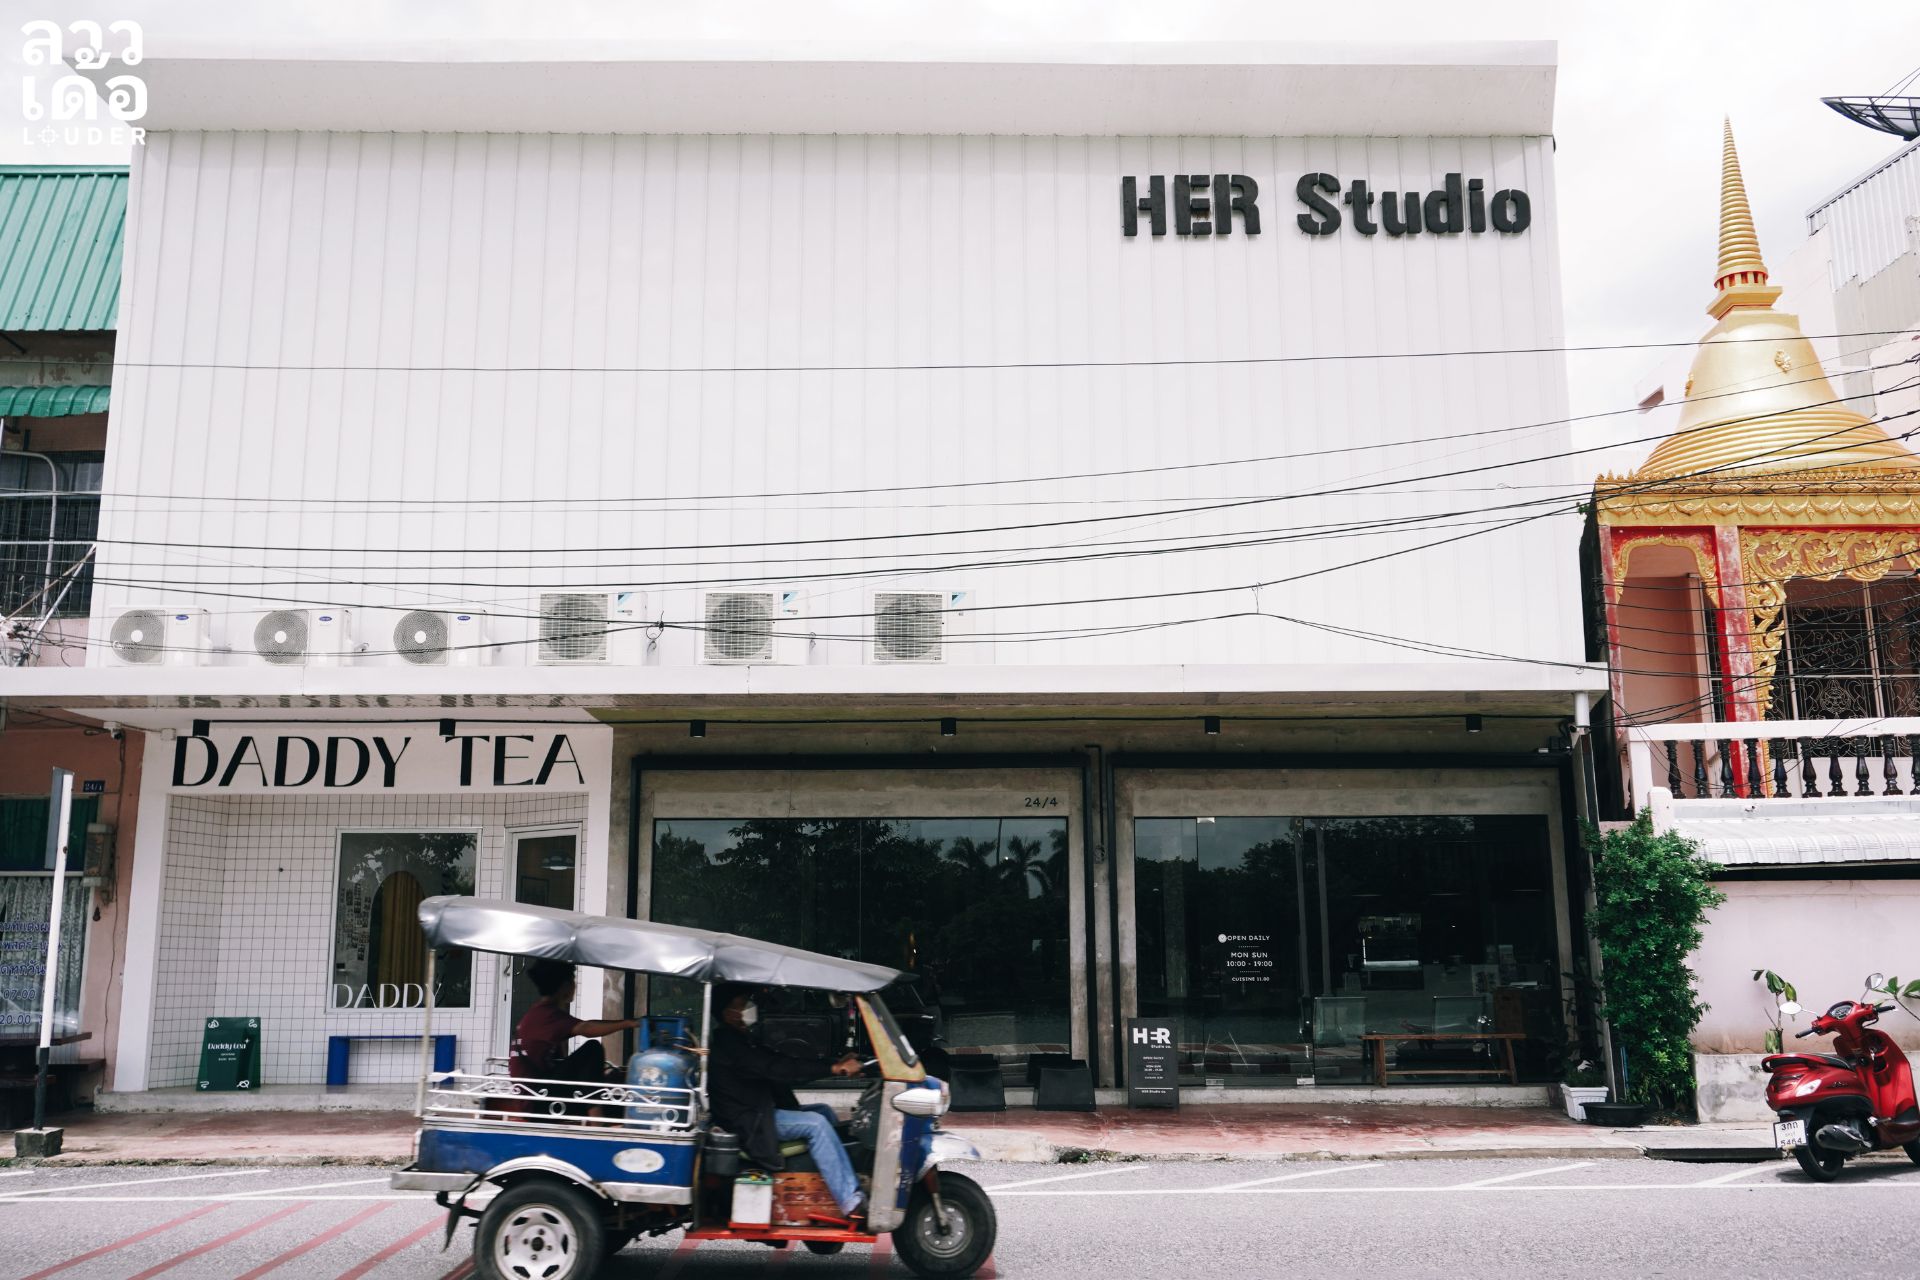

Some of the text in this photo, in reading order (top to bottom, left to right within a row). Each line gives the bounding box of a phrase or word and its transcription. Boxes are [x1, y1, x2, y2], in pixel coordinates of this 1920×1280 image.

[1122, 172, 1531, 236] HER Studio
[172, 734, 585, 787] DADDY TEA
[1024, 796, 1058, 809] 24/4
[333, 983, 442, 1008] DADDY
[1132, 1027, 1171, 1044] HER
